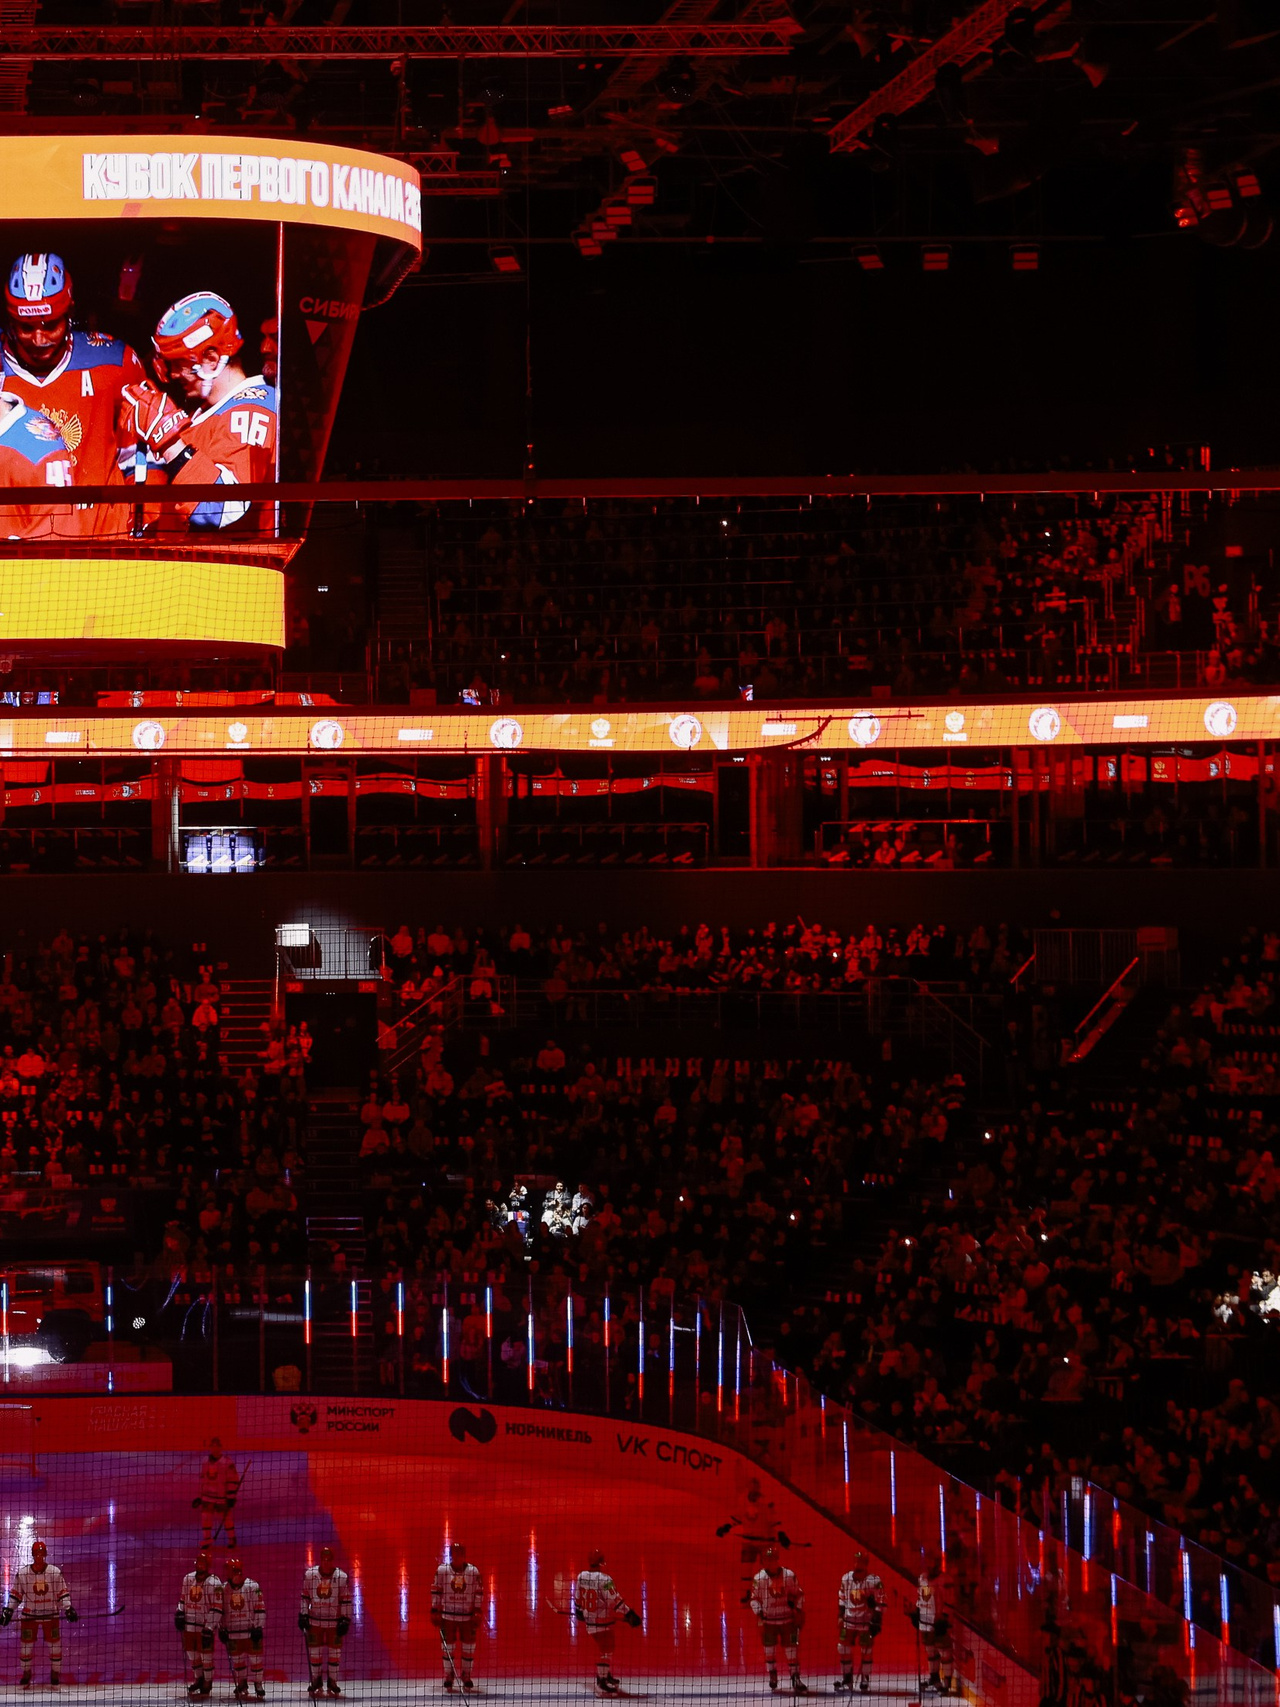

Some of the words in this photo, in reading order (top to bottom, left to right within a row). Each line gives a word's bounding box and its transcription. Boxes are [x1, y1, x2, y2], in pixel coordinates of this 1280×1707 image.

[82, 152, 200, 200] КУБОК
[201, 153, 330, 208] ПЕРВОГО
[332, 163, 406, 225] КАНАЛА
[27, 284, 41, 297] 77
[81, 370, 94, 397] A
[230, 410, 270, 447] 96
[327, 1405, 396, 1419] МИНСПОРТ
[327, 1421, 380, 1432] РОССИИ
[505, 1421, 593, 1445] НОРНИКЕЛЬ
[616, 1432, 651, 1457] VK
[656, 1441, 723, 1477] СПОРТ
